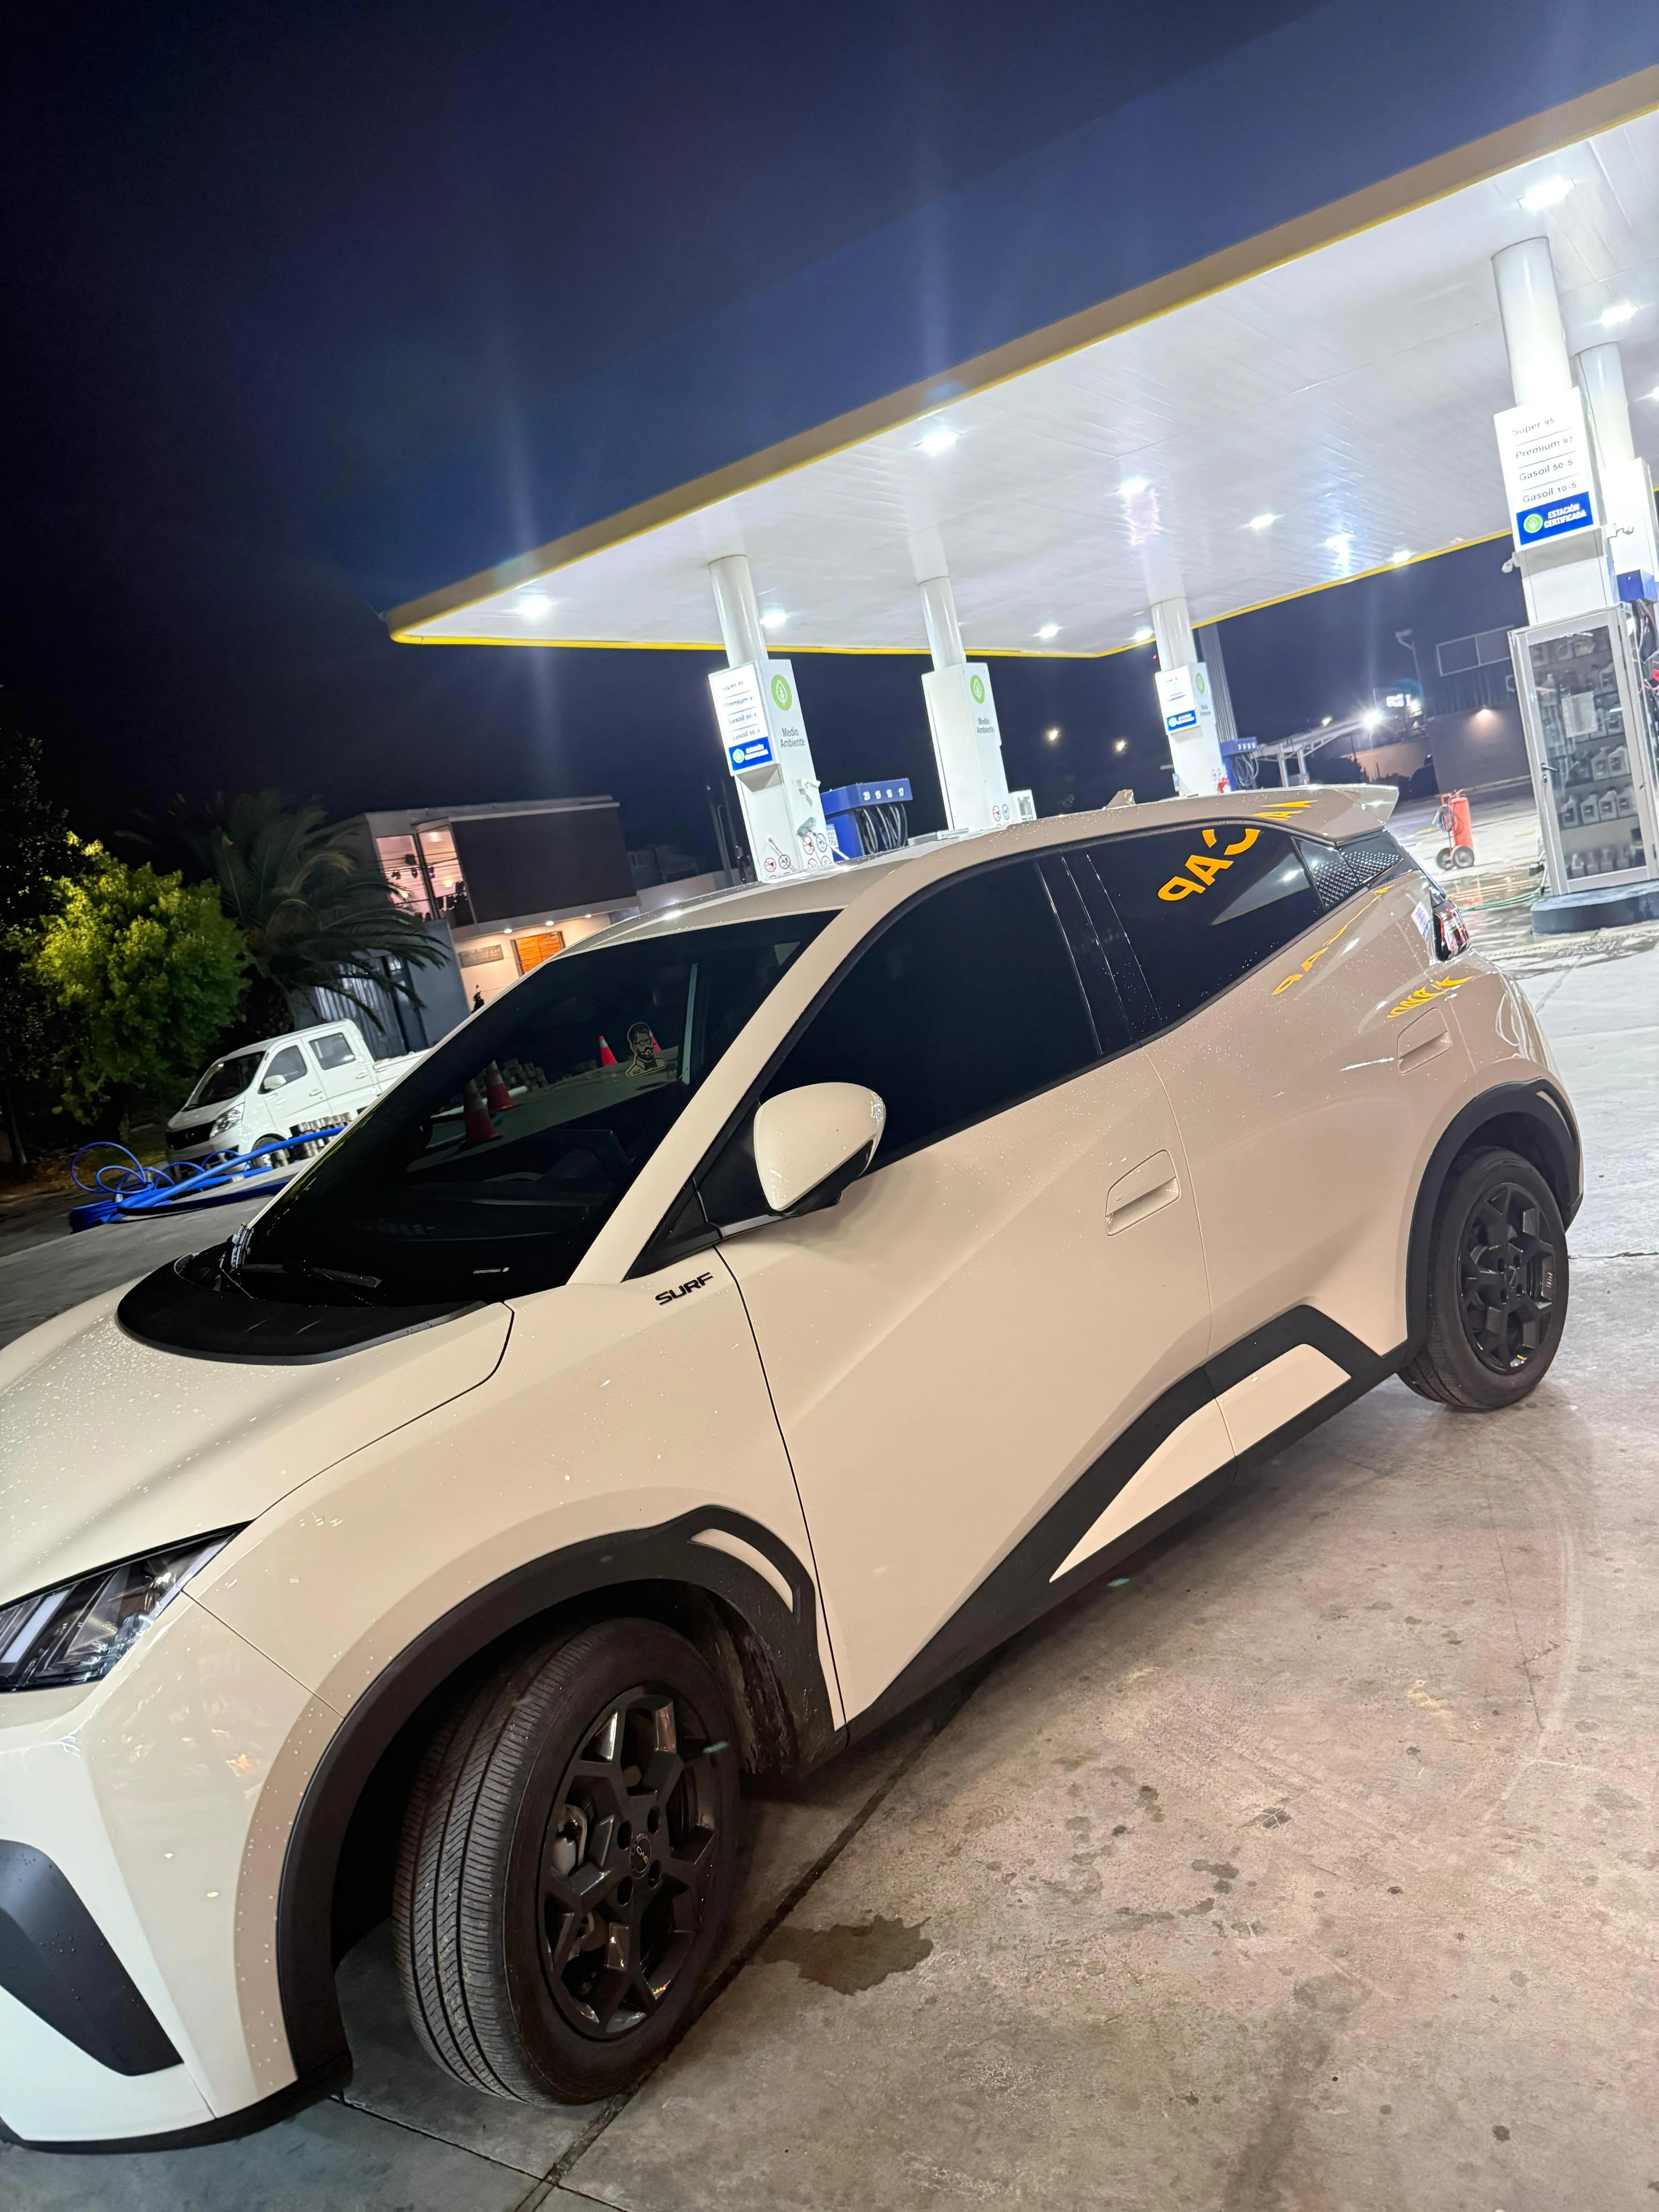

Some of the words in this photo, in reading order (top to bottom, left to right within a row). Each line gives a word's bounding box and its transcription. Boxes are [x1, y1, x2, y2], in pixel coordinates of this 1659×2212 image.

[1513, 422, 1540, 435] Super
[1516, 441, 1560, 459] Premium
[1519, 465, 1550, 480] Gasoil
[1523, 487, 1553, 502] Gasoil
[1544, 509, 1587, 528] CERTIFICADA
[1548, 503, 1580, 519] ESTACIÓN
[782, 727, 798, 737] Medio
[781, 737, 805, 748] Ambiente
[655, 1272, 714, 1305] SURF
